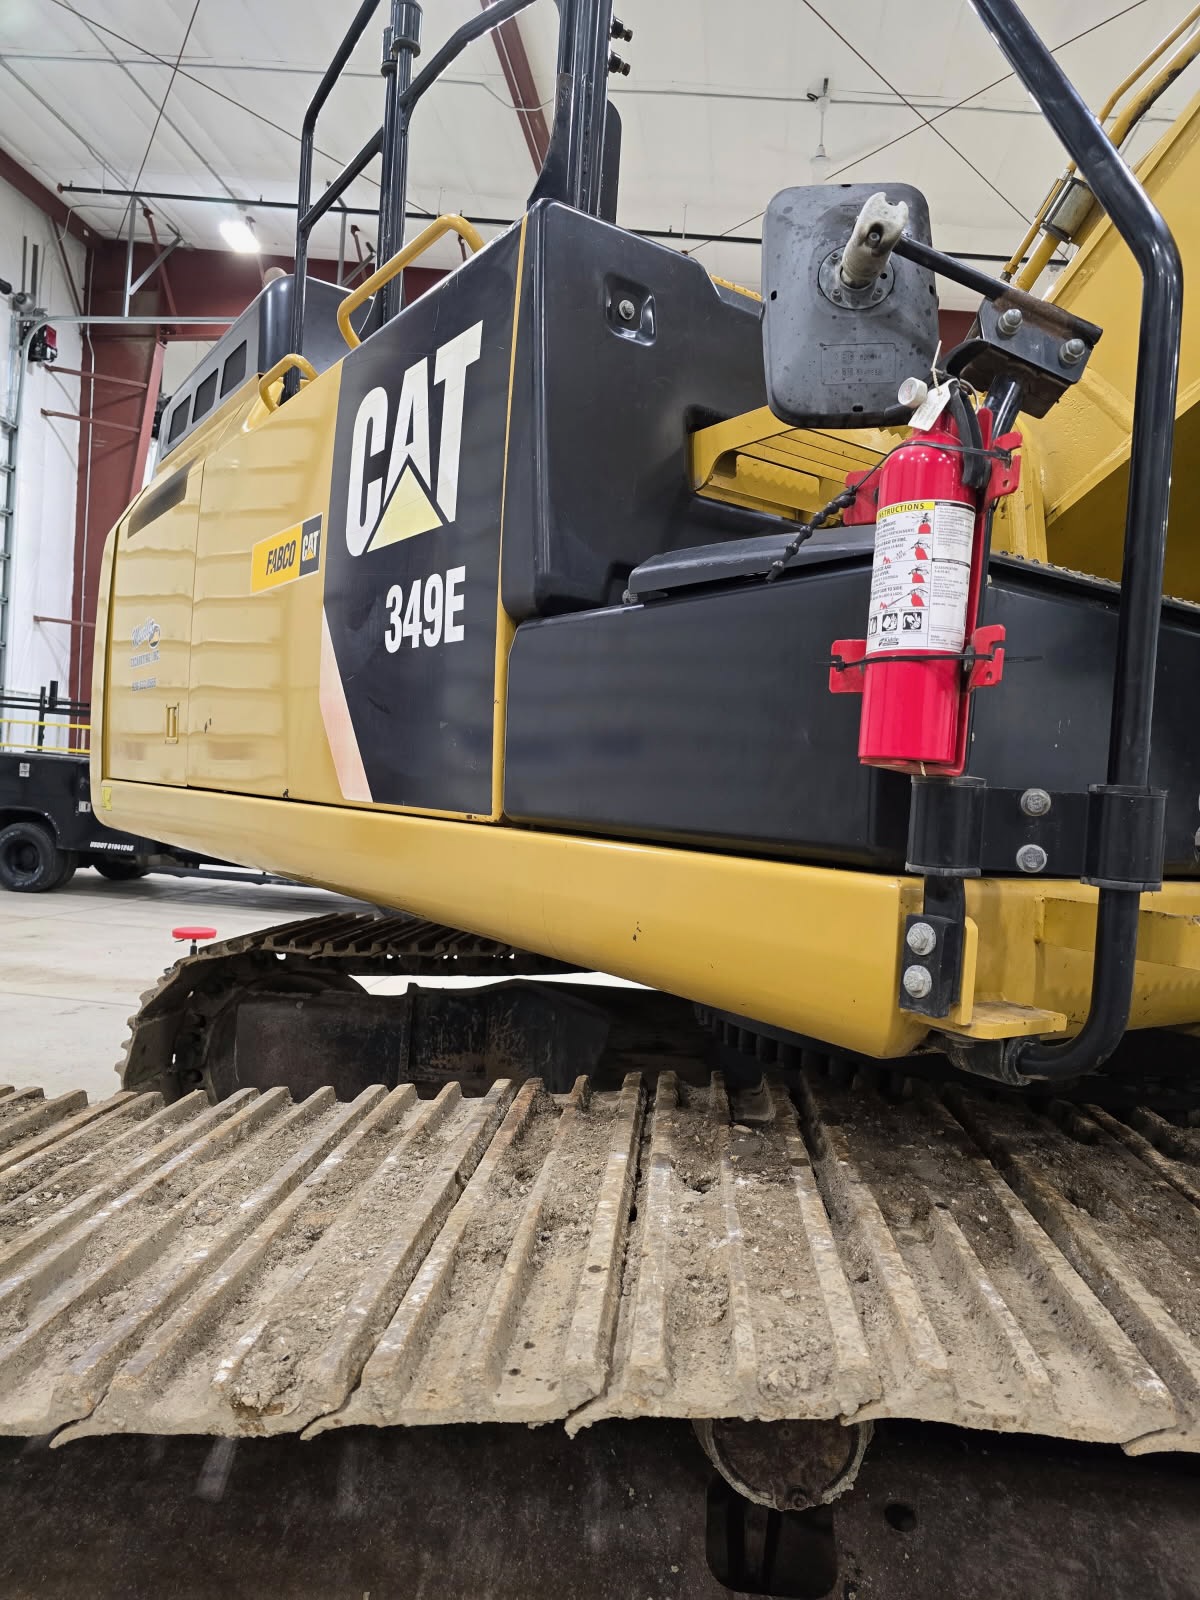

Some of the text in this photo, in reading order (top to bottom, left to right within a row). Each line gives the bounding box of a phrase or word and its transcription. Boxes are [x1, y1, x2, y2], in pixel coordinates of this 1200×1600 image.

[346, 320, 483, 556] CAT
[878, 502, 925, 519] NSTRUCTIONS
[265, 529, 320, 576] FABCO CAT
[385, 566, 466, 653] 349E
[89, 841, 108, 850] USDOT
